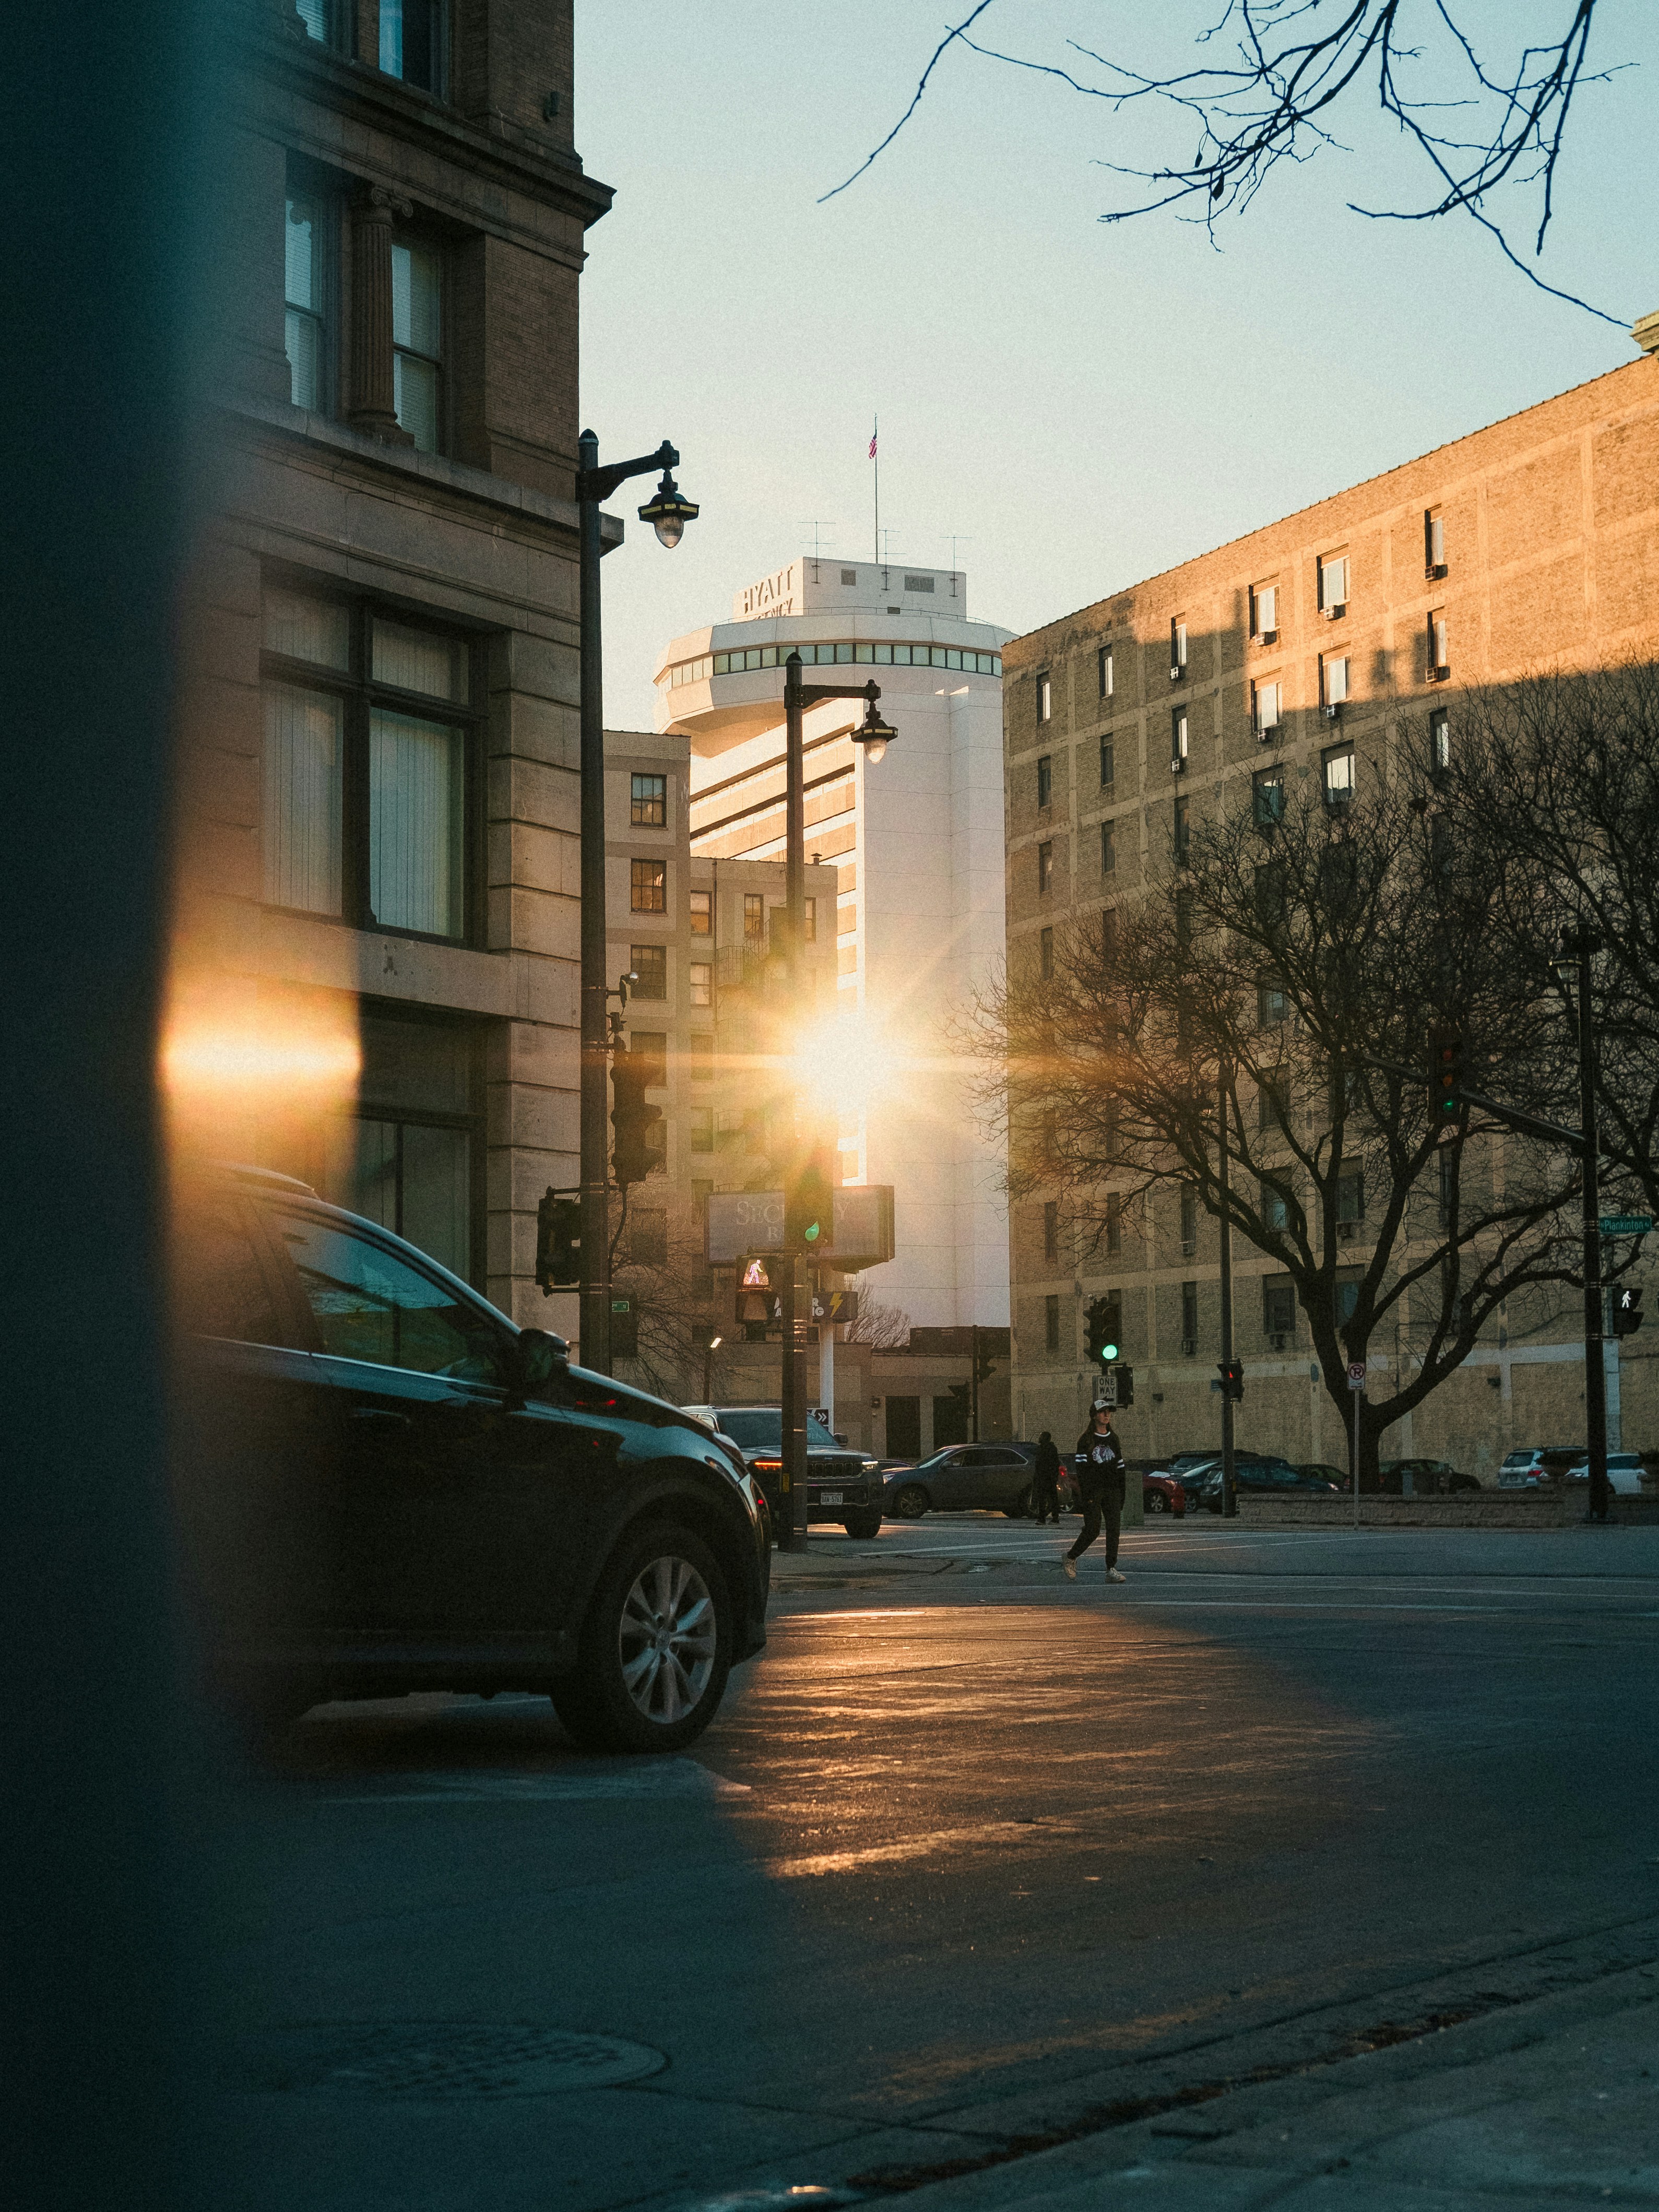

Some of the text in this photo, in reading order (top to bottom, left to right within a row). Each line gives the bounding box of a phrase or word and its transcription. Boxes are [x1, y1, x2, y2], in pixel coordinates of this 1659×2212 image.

[744, 565, 793, 614] HYATT
[1604, 1219, 1643, 1231] Plankinton
[1099, 1377, 1115, 1386] ONE
[1099, 1386, 1115, 1394] WAY
